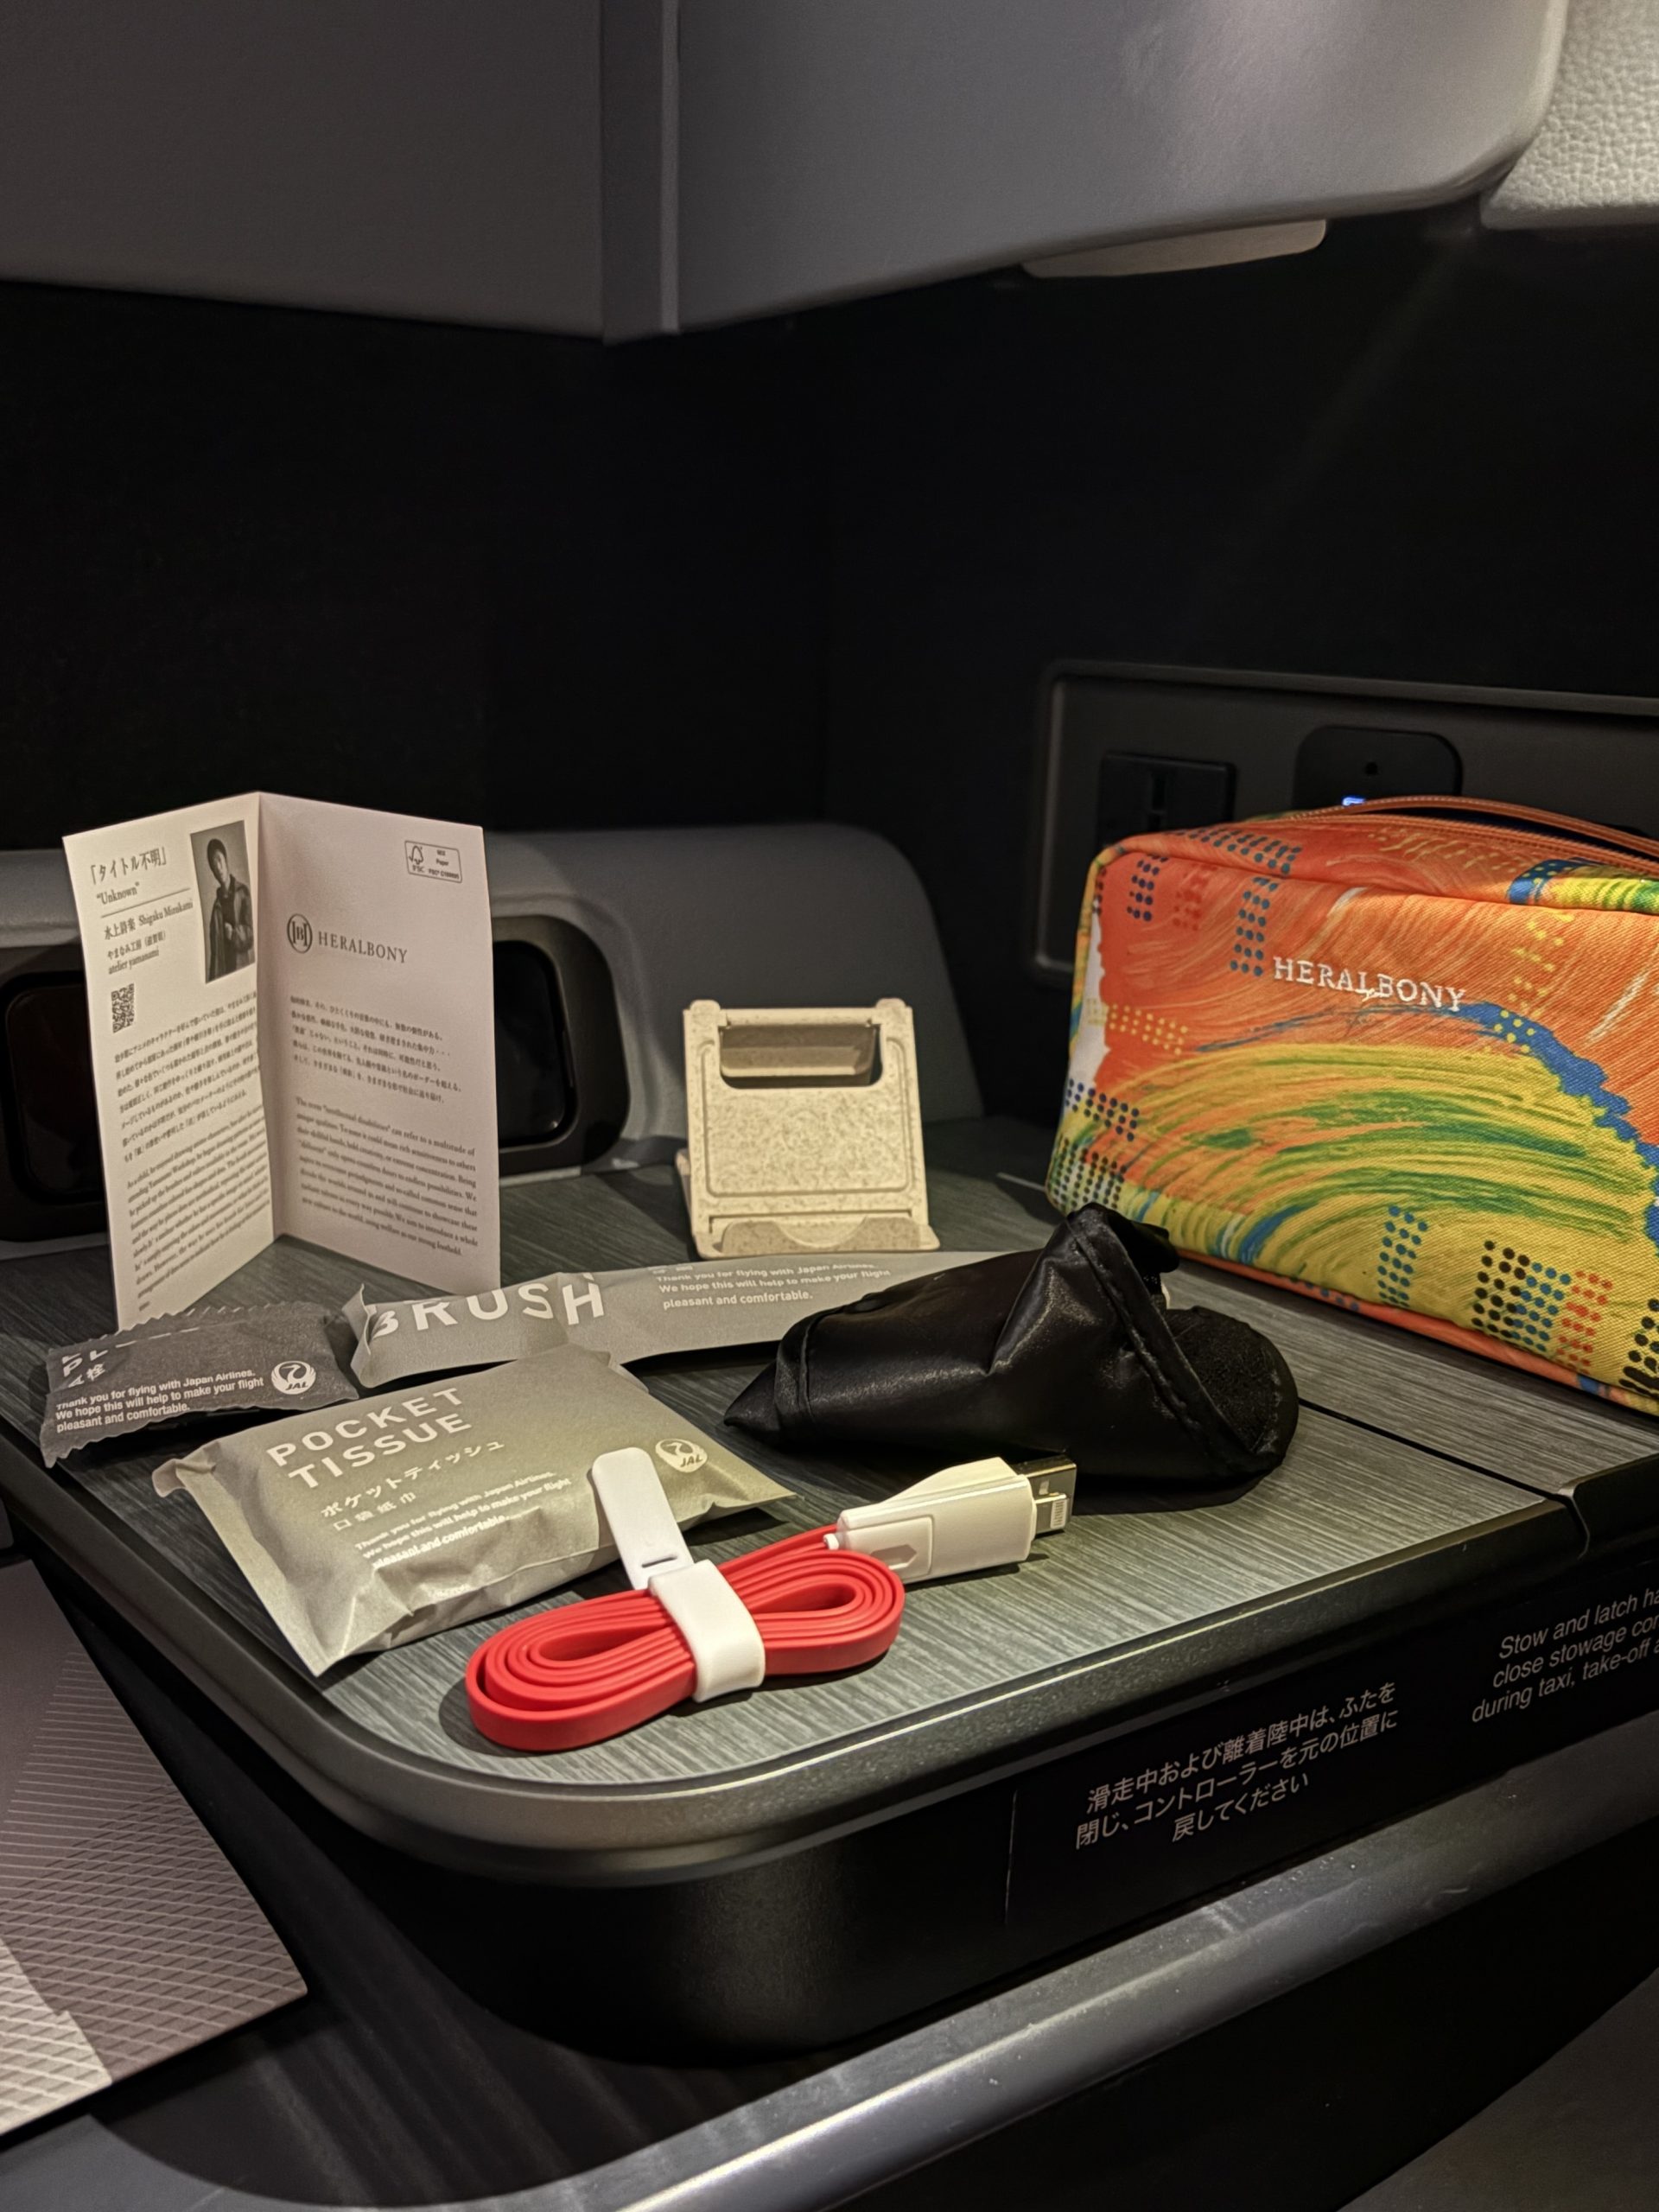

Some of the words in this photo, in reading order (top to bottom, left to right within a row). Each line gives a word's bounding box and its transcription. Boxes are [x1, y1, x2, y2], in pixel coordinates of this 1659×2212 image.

[90, 846, 167, 886] 「タイトル不明」
[318, 931, 408, 963] HERALBONY
[1273, 956, 1467, 1012] HERALBONY
[659, 1284, 678, 1293] We
[681, 1282, 709, 1292] hope
[711, 1281, 734, 1289] this
[735, 1279, 757, 1287] will
[760, 1276, 784, 1287] help
[800, 1275, 831, 1284] make
[833, 1272, 858, 1282] your
[861, 1269, 892, 1279] flight
[798, 1265, 830, 1274] Japan
[663, 1296, 714, 1311] pleasant
[715, 1294, 738, 1305] and
[740, 1289, 814, 1304] comfortable.
[55, 1410, 73, 1420] We
[75, 1405, 101, 1417] hope
[104, 1401, 123, 1412] this
[125, 1396, 143, 1408] will
[146, 1393, 168, 1406] help
[170, 1389, 181, 1401] to
[183, 1384, 212, 1399] make
[213, 1381, 236, 1395] your
[238, 1376, 264, 1391] flight
[56, 1396, 88, 1410] Thank
[90, 1394, 109, 1405] you
[111, 1390, 126, 1400] for
[128, 1384, 156, 1397] flying
[159, 1380, 181, 1392] with
[183, 1376, 213, 1389] Japan
[215, 1369, 257, 1382] Airlines.
[57, 1416, 103, 1433] pleasant
[105, 1412, 124, 1424] and
[126, 1403, 191, 1421] comfortable.
[266, 1387, 463, 1467] POCKET
[288, 1413, 473, 1489] TISSUE
[321, 1440, 505, 1517] ポケットティッシュ
[363, 1548, 382, 1558] We
[382, 1535, 410, 1549] hope
[410, 1525, 433, 1537] this
[433, 1516, 454, 1529] will
[454, 1509, 478, 1521] help
[491, 1496, 520, 1509] make
[520, 1487, 543, 1500] your
[543, 1478, 572, 1491] flight
[390, 1522, 410, 1535] you
[420, 1536, 442, 1553] and
[1498, 1628, 1549, 1659] Stow
[1553, 1609, 1592, 1641] and
[1594, 1594, 1638, 1625] latch
[1471, 1687, 1533, 1723] during
[1538, 1667, 1576, 1698] taxi,
[1582, 1637, 1652, 1681] take-off
[1492, 1656, 1544, 1688] close
[1548, 1626, 1627, 1668] stowage
[1086, 1681, 1396, 1815] 滑走中および離着陸中は、ふたを
[1075, 1709, 1399, 1850] 閉じ、コントローラーを元の位置に
[1172, 1772, 1310, 1842] 戻してください
